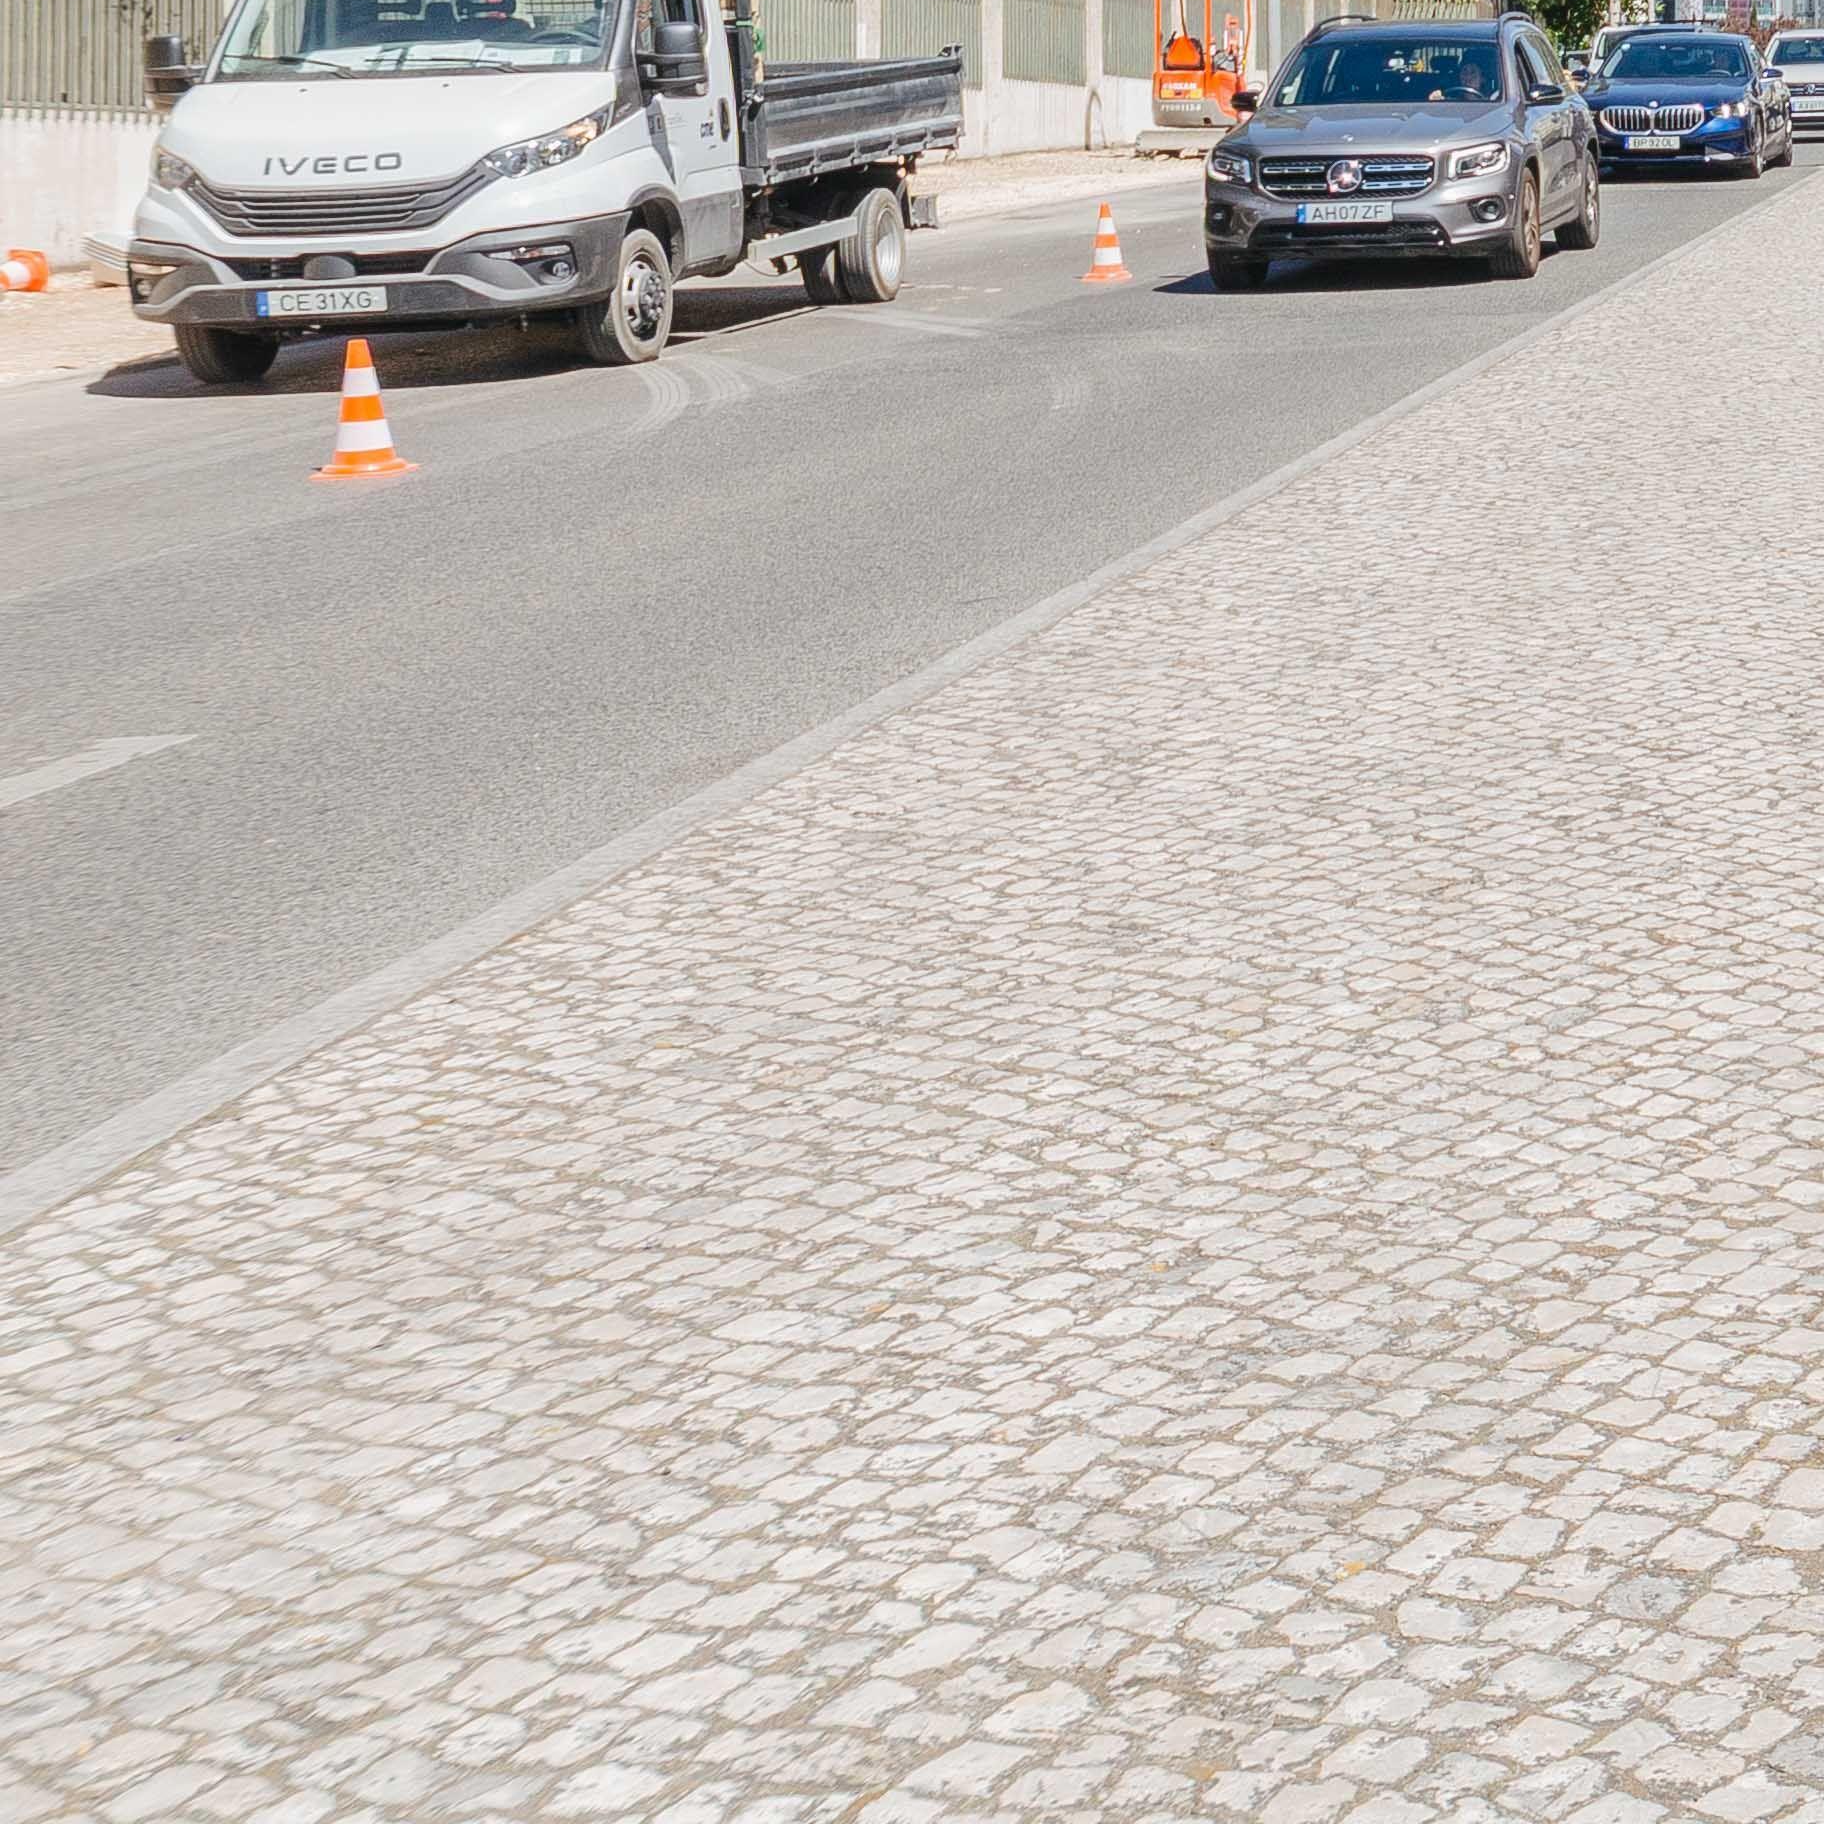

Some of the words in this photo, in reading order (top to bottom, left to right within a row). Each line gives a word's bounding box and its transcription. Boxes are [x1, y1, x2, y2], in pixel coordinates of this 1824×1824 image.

[263, 151, 402, 176] IVECO
[1311, 204, 1385, 221] AH07ZF
[279, 290, 372, 312] CE31XG
